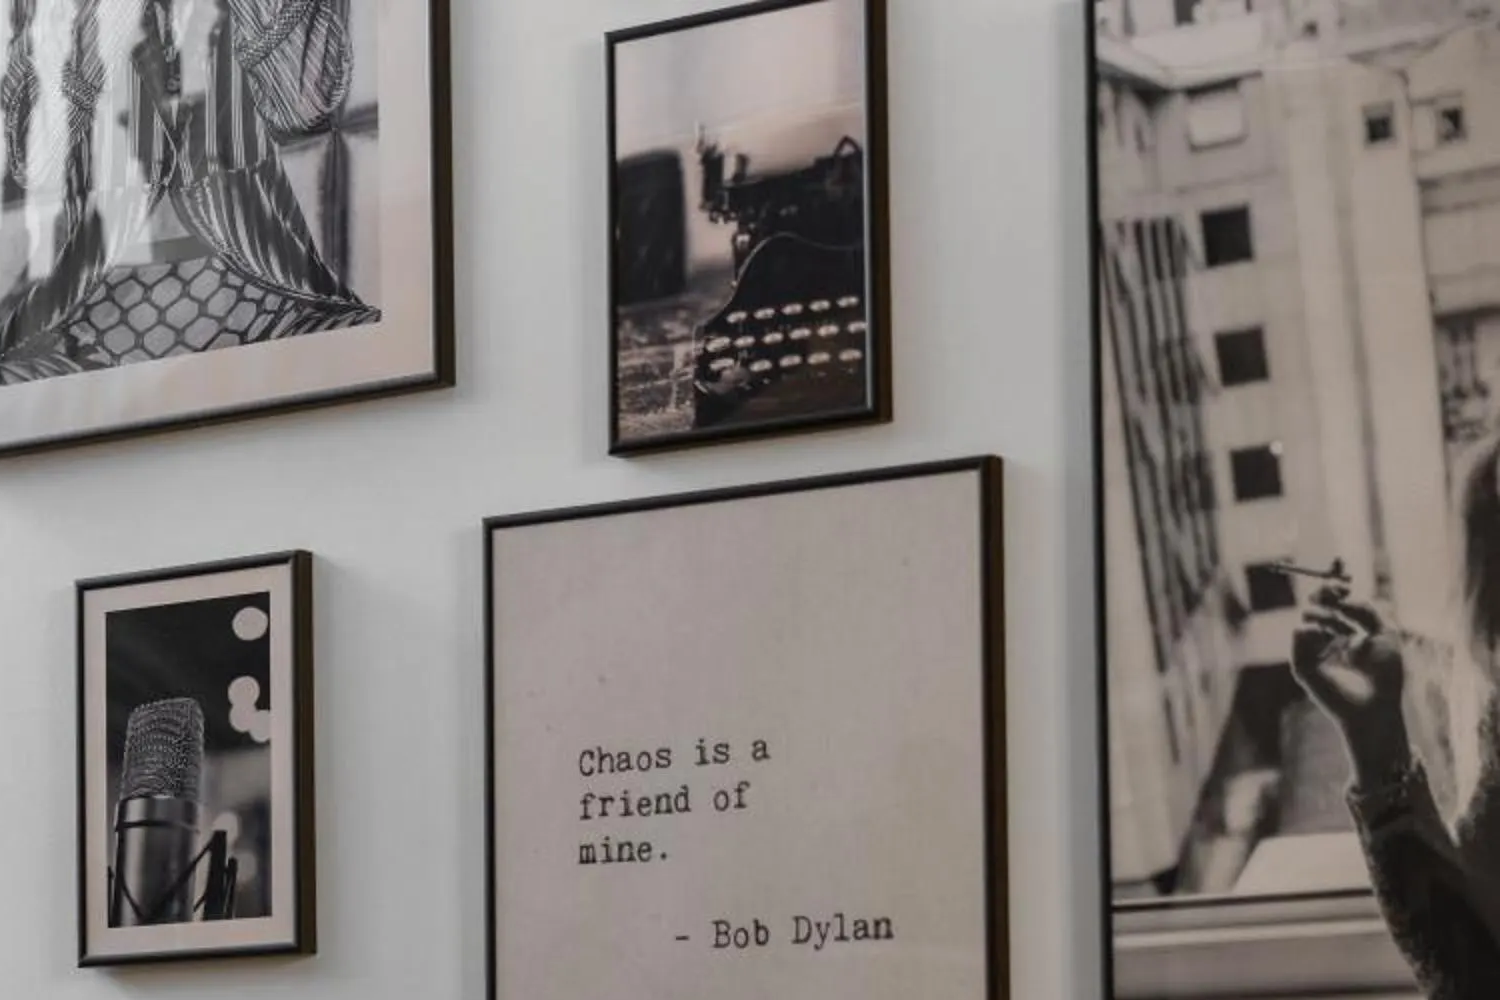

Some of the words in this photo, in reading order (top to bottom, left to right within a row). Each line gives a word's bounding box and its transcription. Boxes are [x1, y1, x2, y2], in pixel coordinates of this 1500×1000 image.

[578, 746, 673, 777] Chaos
[694, 738, 731, 766] is
[751, 738, 771, 762] a
[579, 784, 692, 821] friend
[712, 780, 751, 812] of
[578, 835, 668, 865] mine.
[711, 918, 771, 950] Bob
[791, 912, 895, 951] Dylan
